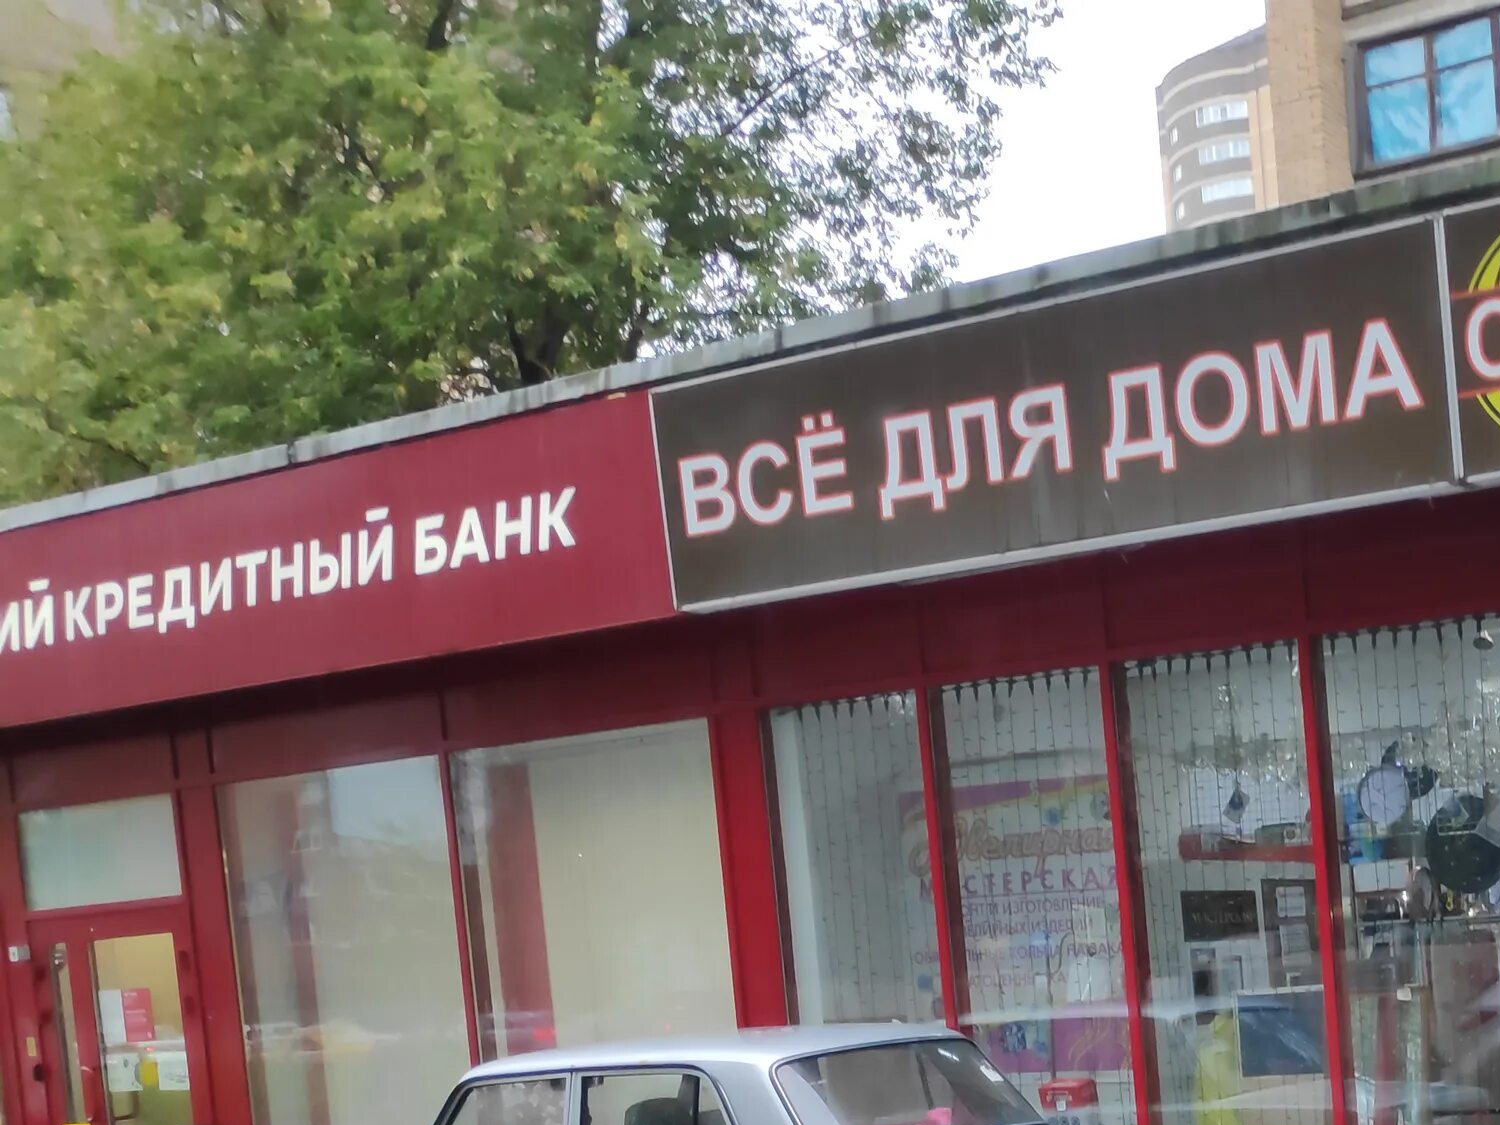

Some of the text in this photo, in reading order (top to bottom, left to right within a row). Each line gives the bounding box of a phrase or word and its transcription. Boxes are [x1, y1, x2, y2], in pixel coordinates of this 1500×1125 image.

[678, 318, 1423, 538] ВСЁ ДЛЯ ДОМА
[64, 508, 394, 642] КРЕДИТНЫЙ
[414, 486, 576, 576] БАНК
